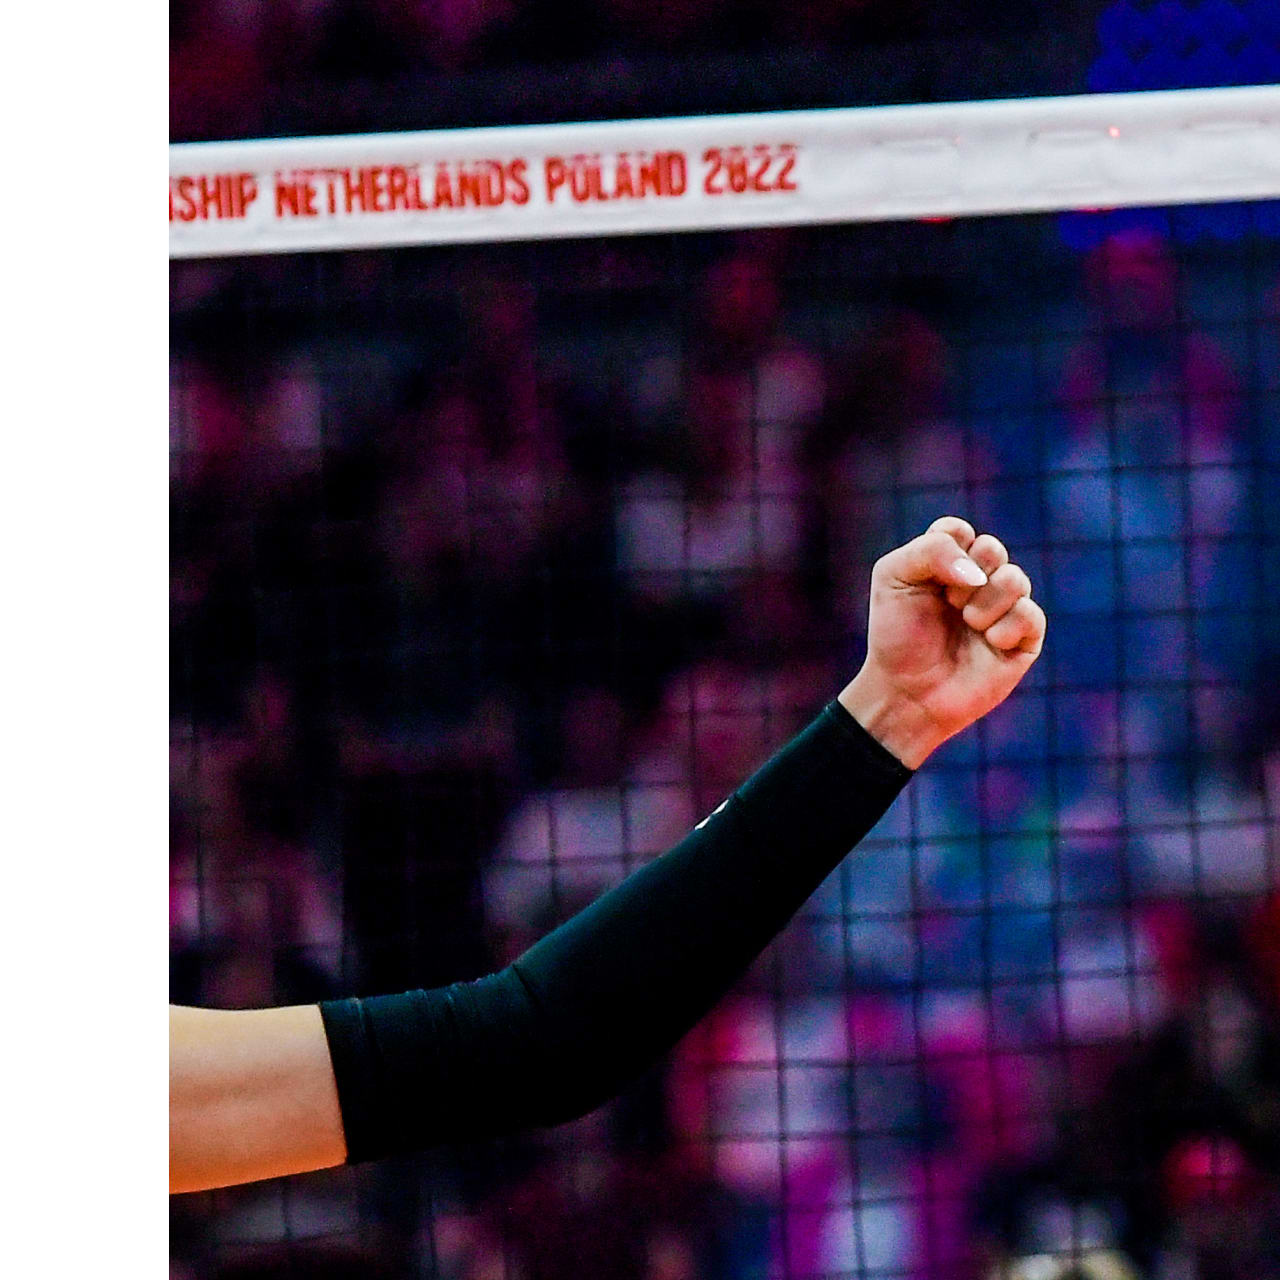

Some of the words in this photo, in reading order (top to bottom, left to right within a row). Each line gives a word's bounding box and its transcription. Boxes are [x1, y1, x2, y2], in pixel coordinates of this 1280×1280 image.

[169, 171, 258, 223] SHIP
[274, 156, 531, 219] NETHERLANDS
[543, 148, 688, 205] POLAND
[702, 143, 799, 196] 2022
